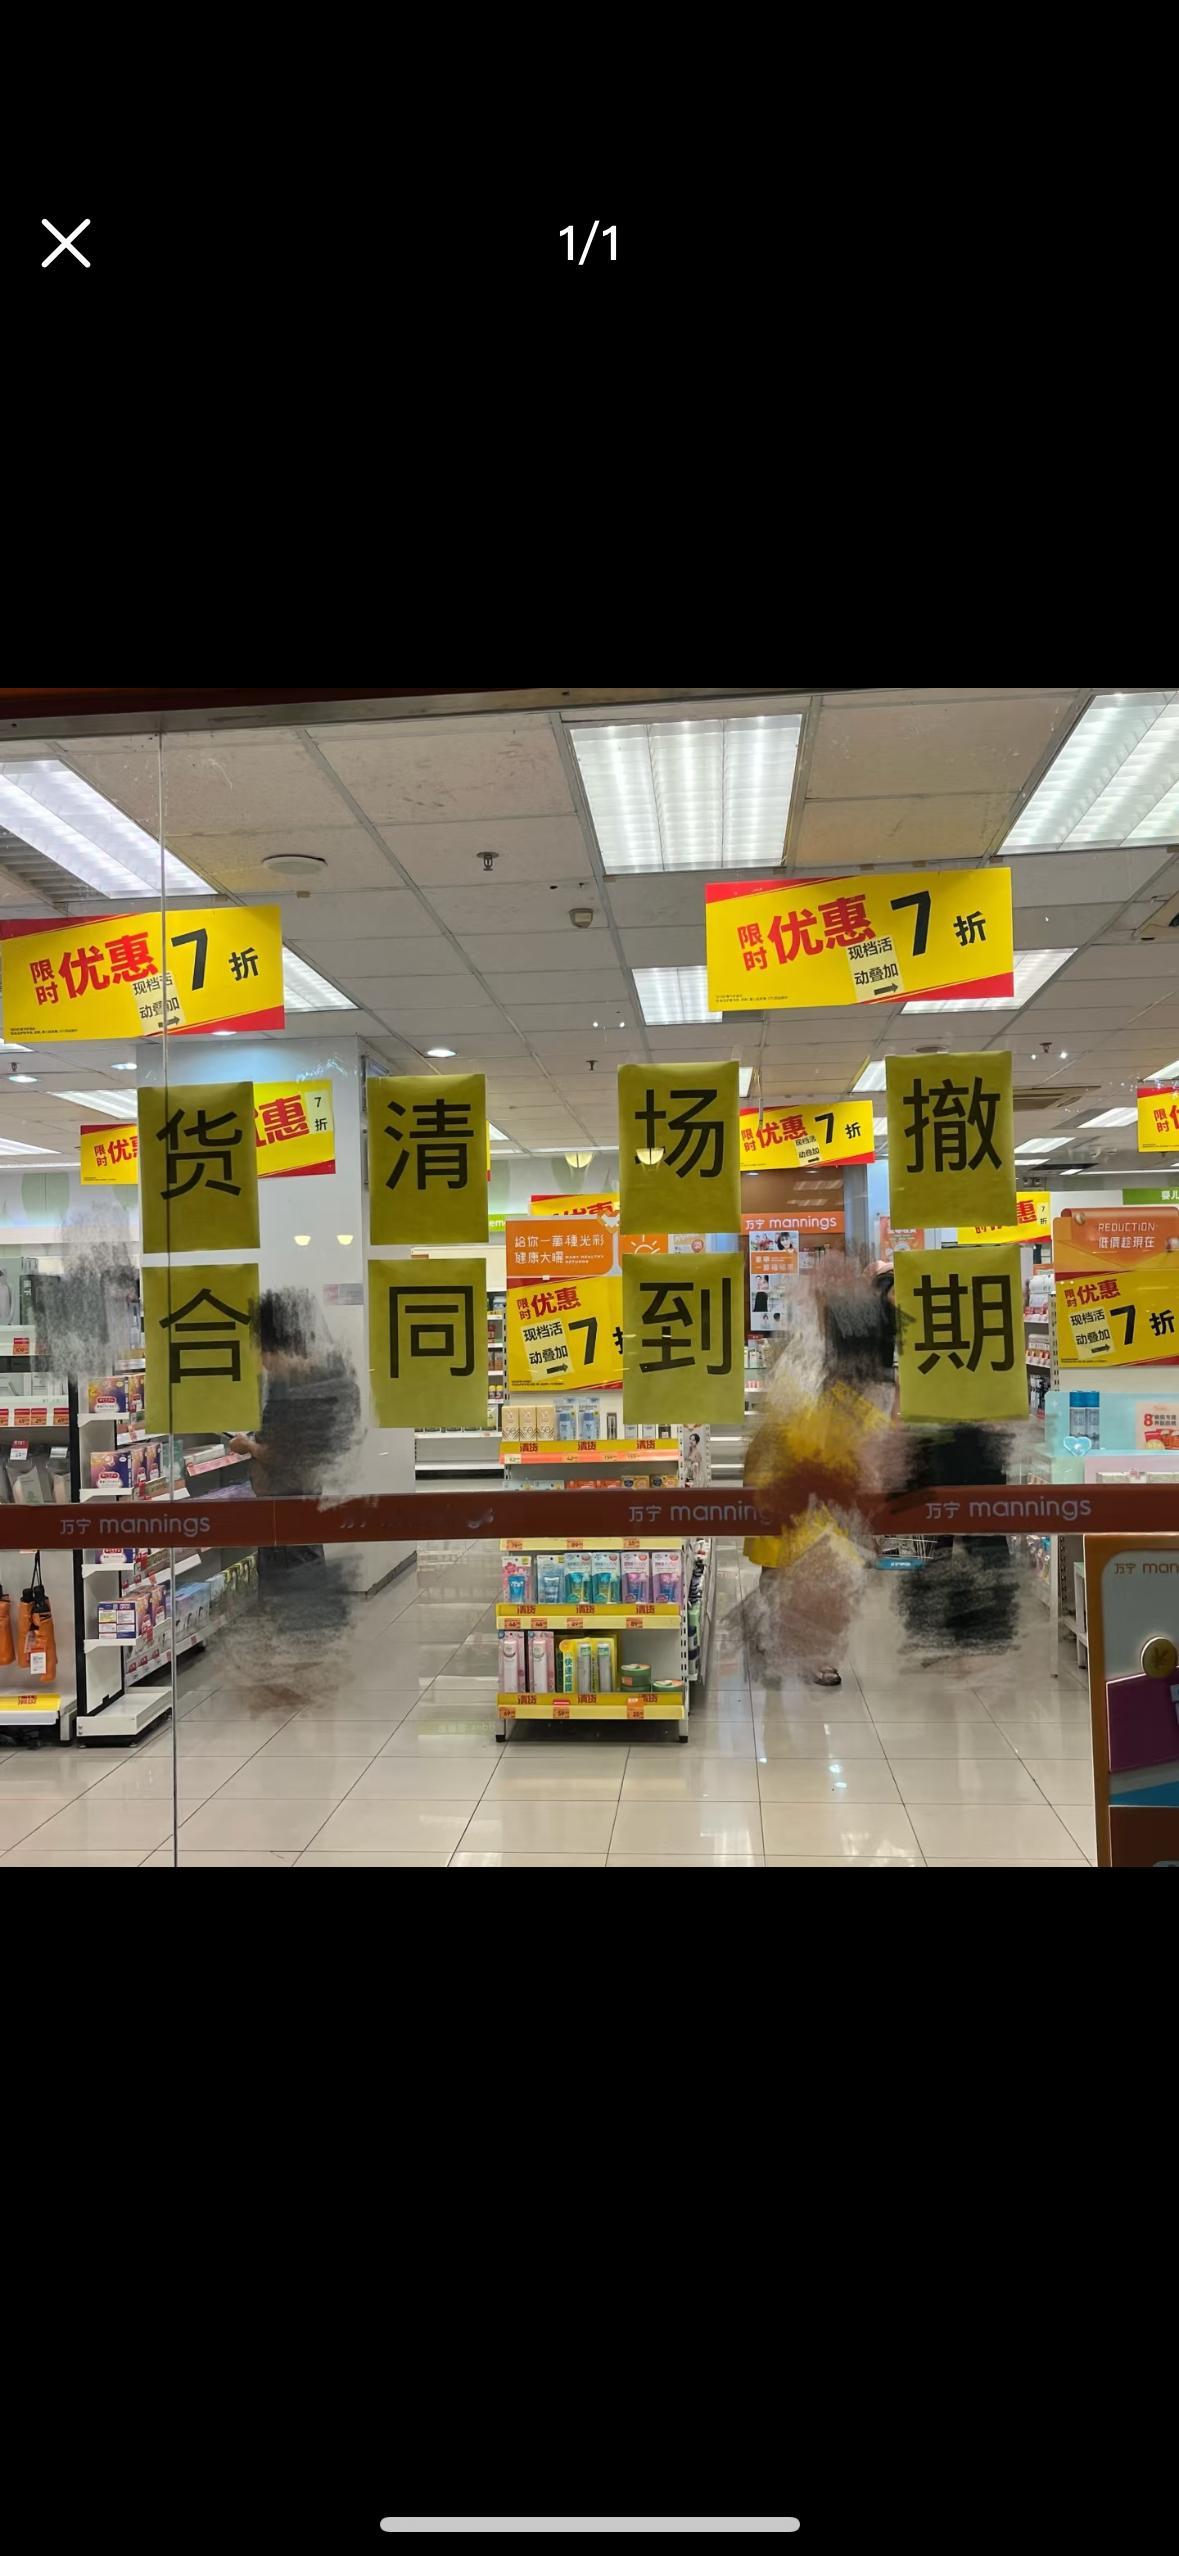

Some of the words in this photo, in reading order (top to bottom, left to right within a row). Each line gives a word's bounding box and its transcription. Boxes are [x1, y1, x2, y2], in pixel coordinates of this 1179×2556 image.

[767, 894, 877, 964] 优惠
[890, 890, 931, 957] 7
[953, 910, 986, 946] 折
[737, 922, 768, 971] 限时
[848, 937, 892, 961] 现档活
[58, 932, 158, 999] 优惠
[171, 928, 208, 991] 7
[228, 947, 259, 981] 折
[854, 963, 899, 985] 动叠加
[30, 958, 58, 1005] 限时
[155, 1108, 243, 1200] 货
[384, 1099, 474, 1190] 清
[635, 1088, 724, 1178] 场
[903, 1077, 1003, 1173] 撤
[741, 1128, 756, 1152] 限时
[756, 1114, 808, 1149] 优惠
[814, 1112, 835, 1144] 7
[845, 1122, 861, 1139] 折
[745, 1219, 765, 1230] 万宁
[769, 1215, 837, 1230] mannings
[1098, 1222, 1155, 1232] REDUCTION
[531, 1286, 581, 1317] 优惠
[1064, 1289, 1077, 1307] 限时
[1077, 1279, 1120, 1305] 优惠
[517, 1298, 531, 1320] 限时
[1070, 1309, 1105, 1326] 现档活
[159, 1288, 252, 1384] 合
[389, 1286, 474, 1378] 同
[639, 1274, 731, 1374] 到
[914, 1273, 1015, 1374] 期
[523, 1321, 563, 1342] 现档活
[1075, 1329, 1110, 1345] 动叠加
[1109, 1305, 1136, 1345] 7
[1149, 1309, 1174, 1336] 折
[568, 1317, 598, 1365] 7
[529, 1345, 568, 1364] 动叠加
[628, 1504, 662, 1522] 万宁
[925, 1502, 960, 1519] 万宁
[969, 1496, 1091, 1521] mannings
[60, 1518, 91, 1535] 万宁
[100, 1513, 210, 1537] mannings
